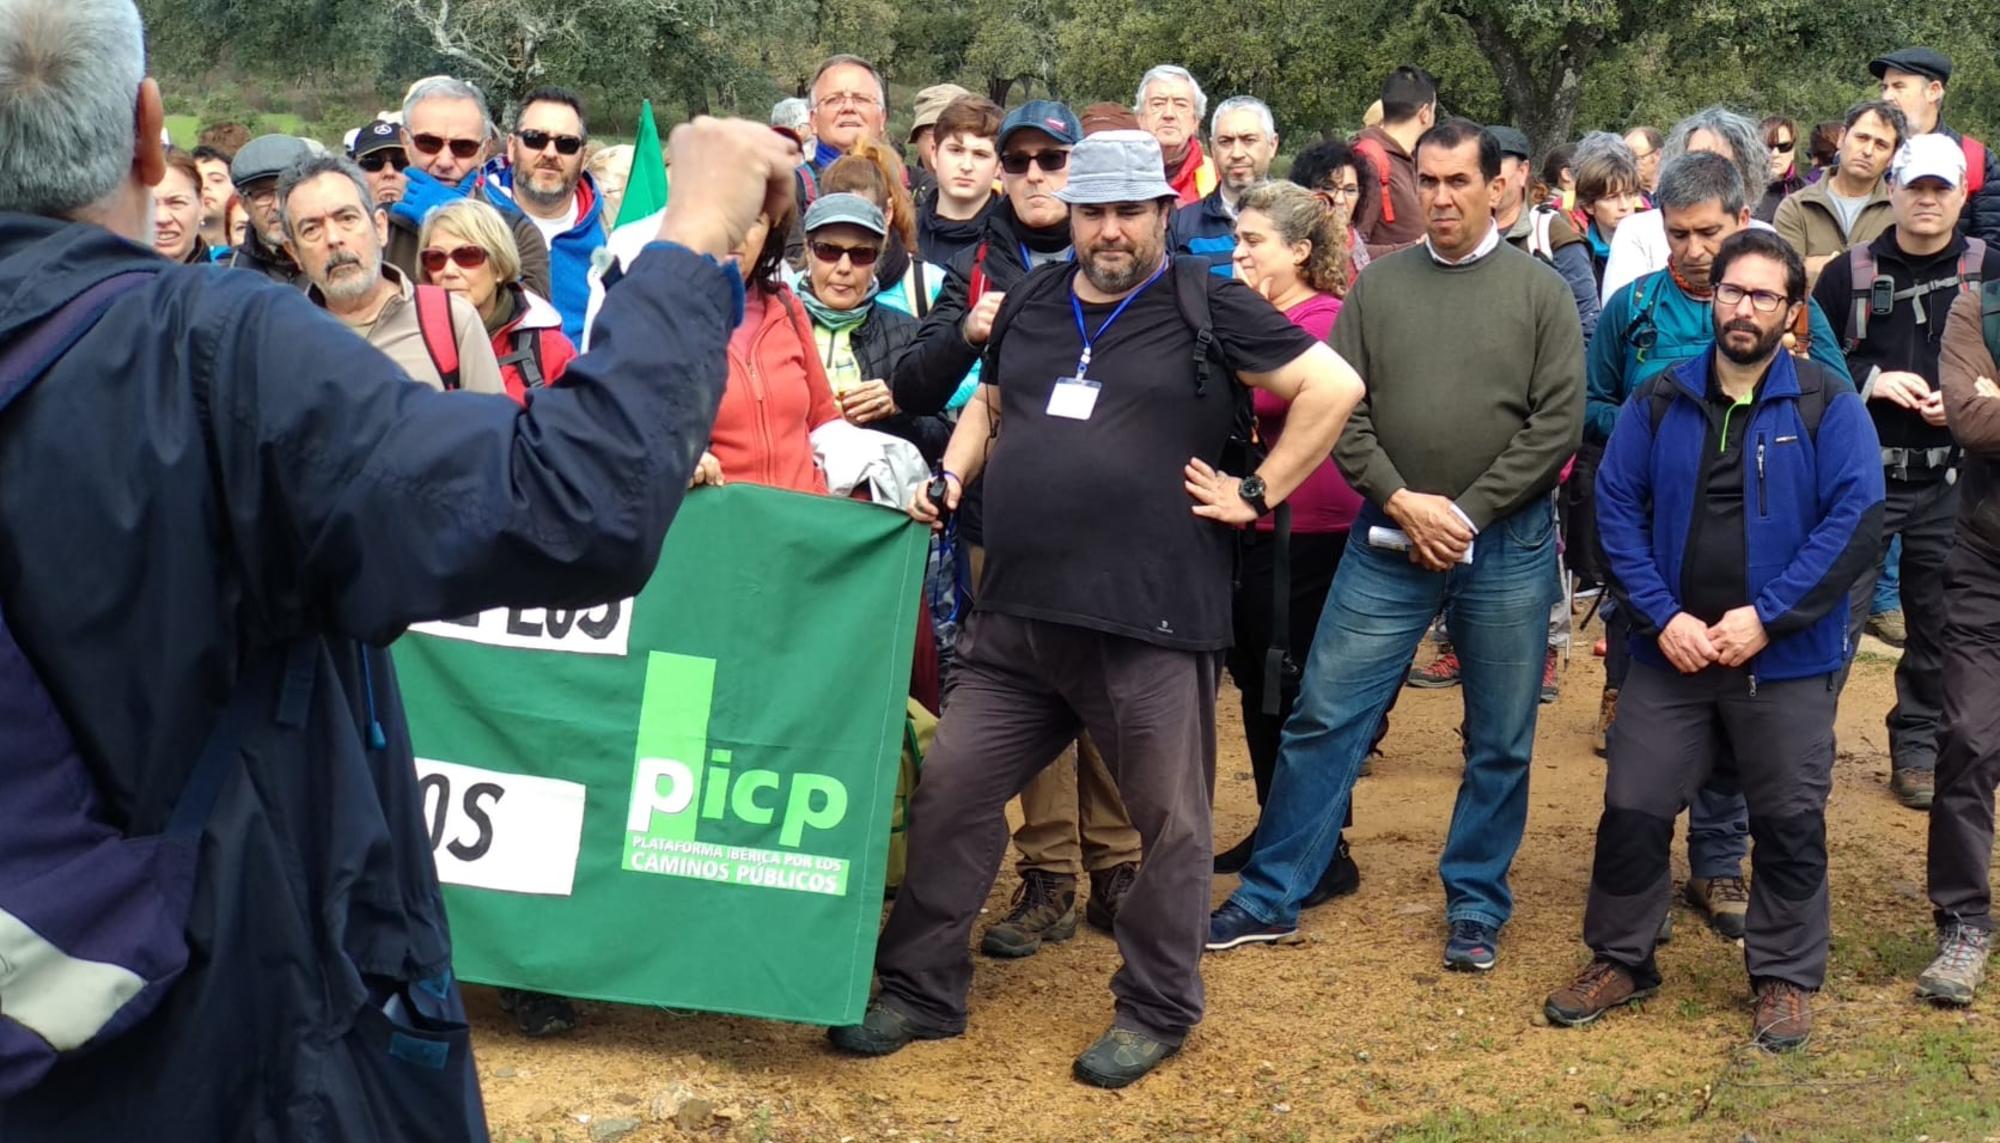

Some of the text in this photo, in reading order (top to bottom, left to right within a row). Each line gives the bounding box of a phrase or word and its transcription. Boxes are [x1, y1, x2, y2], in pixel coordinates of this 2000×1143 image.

[627, 749, 848, 848] picp
[630, 851, 838, 894] CAMINOS PÚBLICOS
[632, 835, 842, 873] PLATAFORMA IBÉRICA POR LOS
